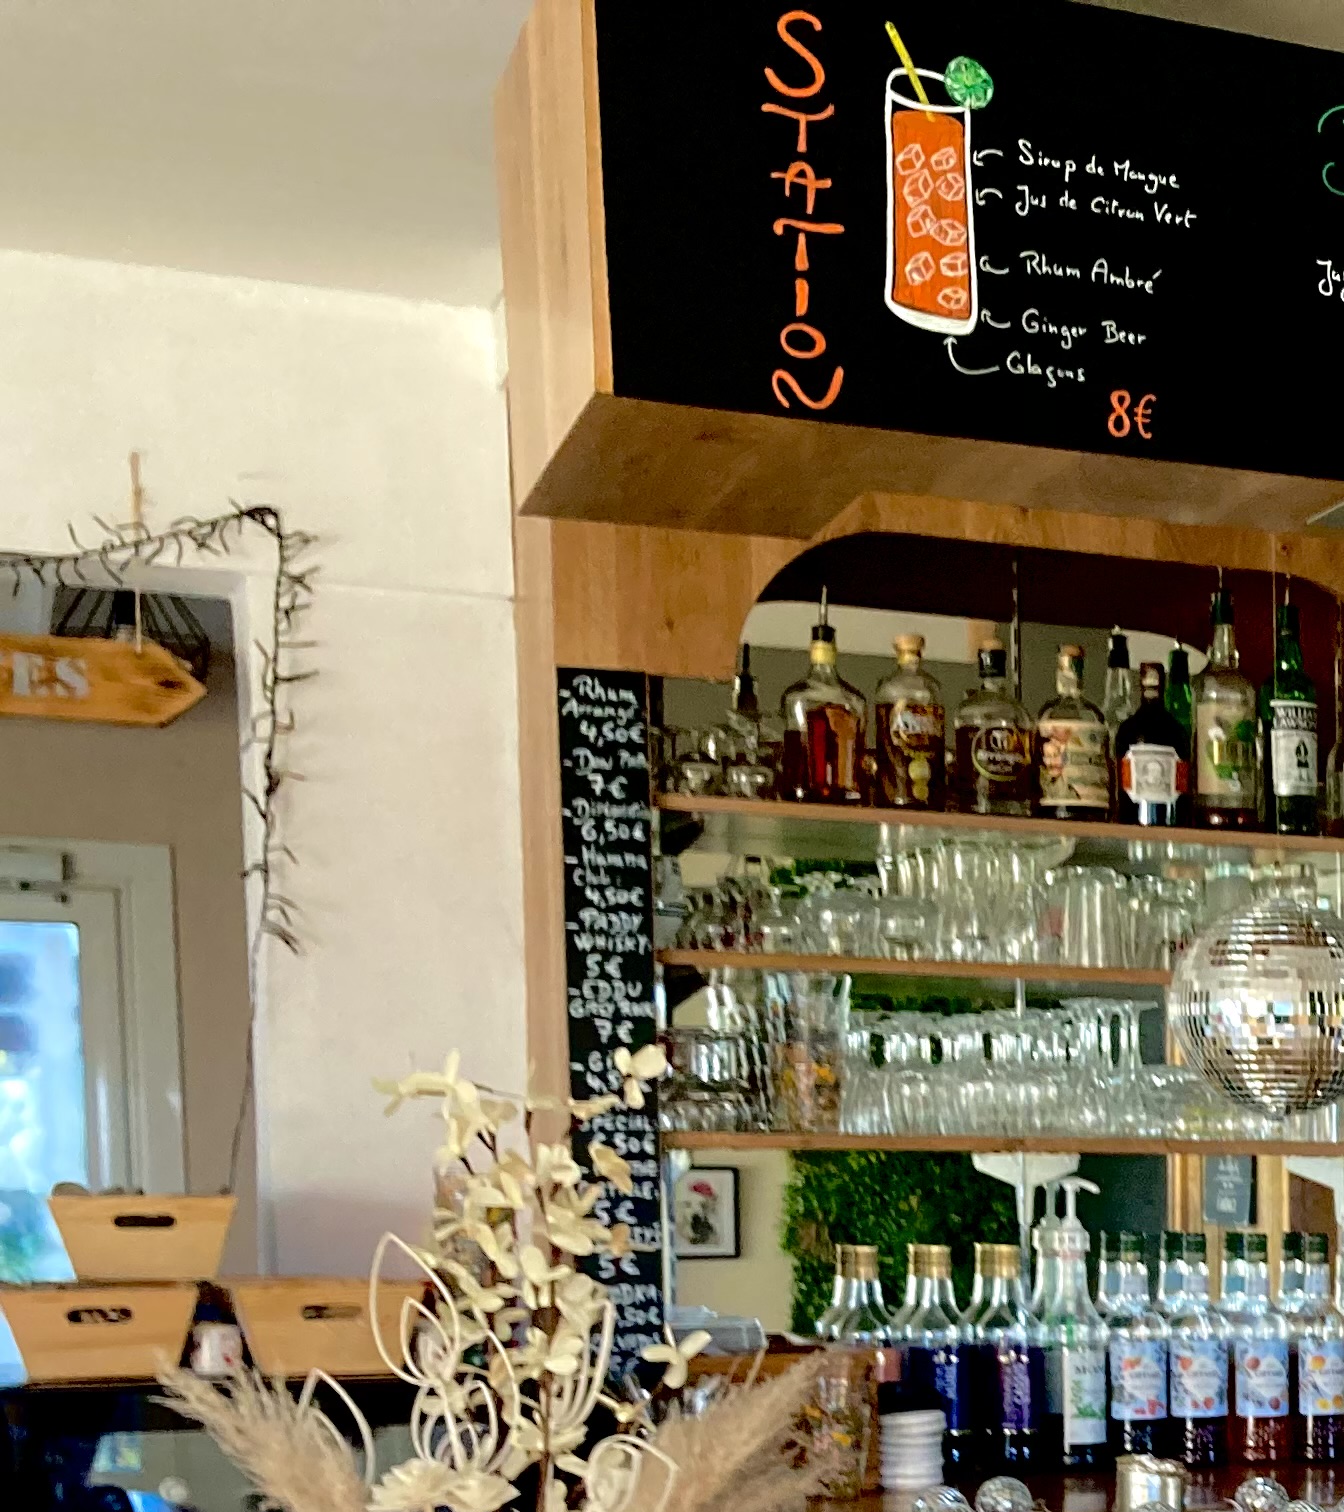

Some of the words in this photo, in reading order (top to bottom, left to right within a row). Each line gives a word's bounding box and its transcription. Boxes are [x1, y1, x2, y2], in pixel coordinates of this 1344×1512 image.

[1085, 155, 1105, 177] de
[1113, 159, 1180, 195] Mangue
[760, 9, 845, 409] STATION
[1014, 184, 1047, 217] Jus
[1059, 190, 1077, 210] de
[1153, 201, 1197, 229] Vert
[1019, 250, 1081, 279] Rhum
[1091, 257, 1162, 294] Ambré
[1021, 307, 1087, 350] Ginger
[1101, 320, 1147, 345] Beer
[1107, 389, 1157, 440] 8€
